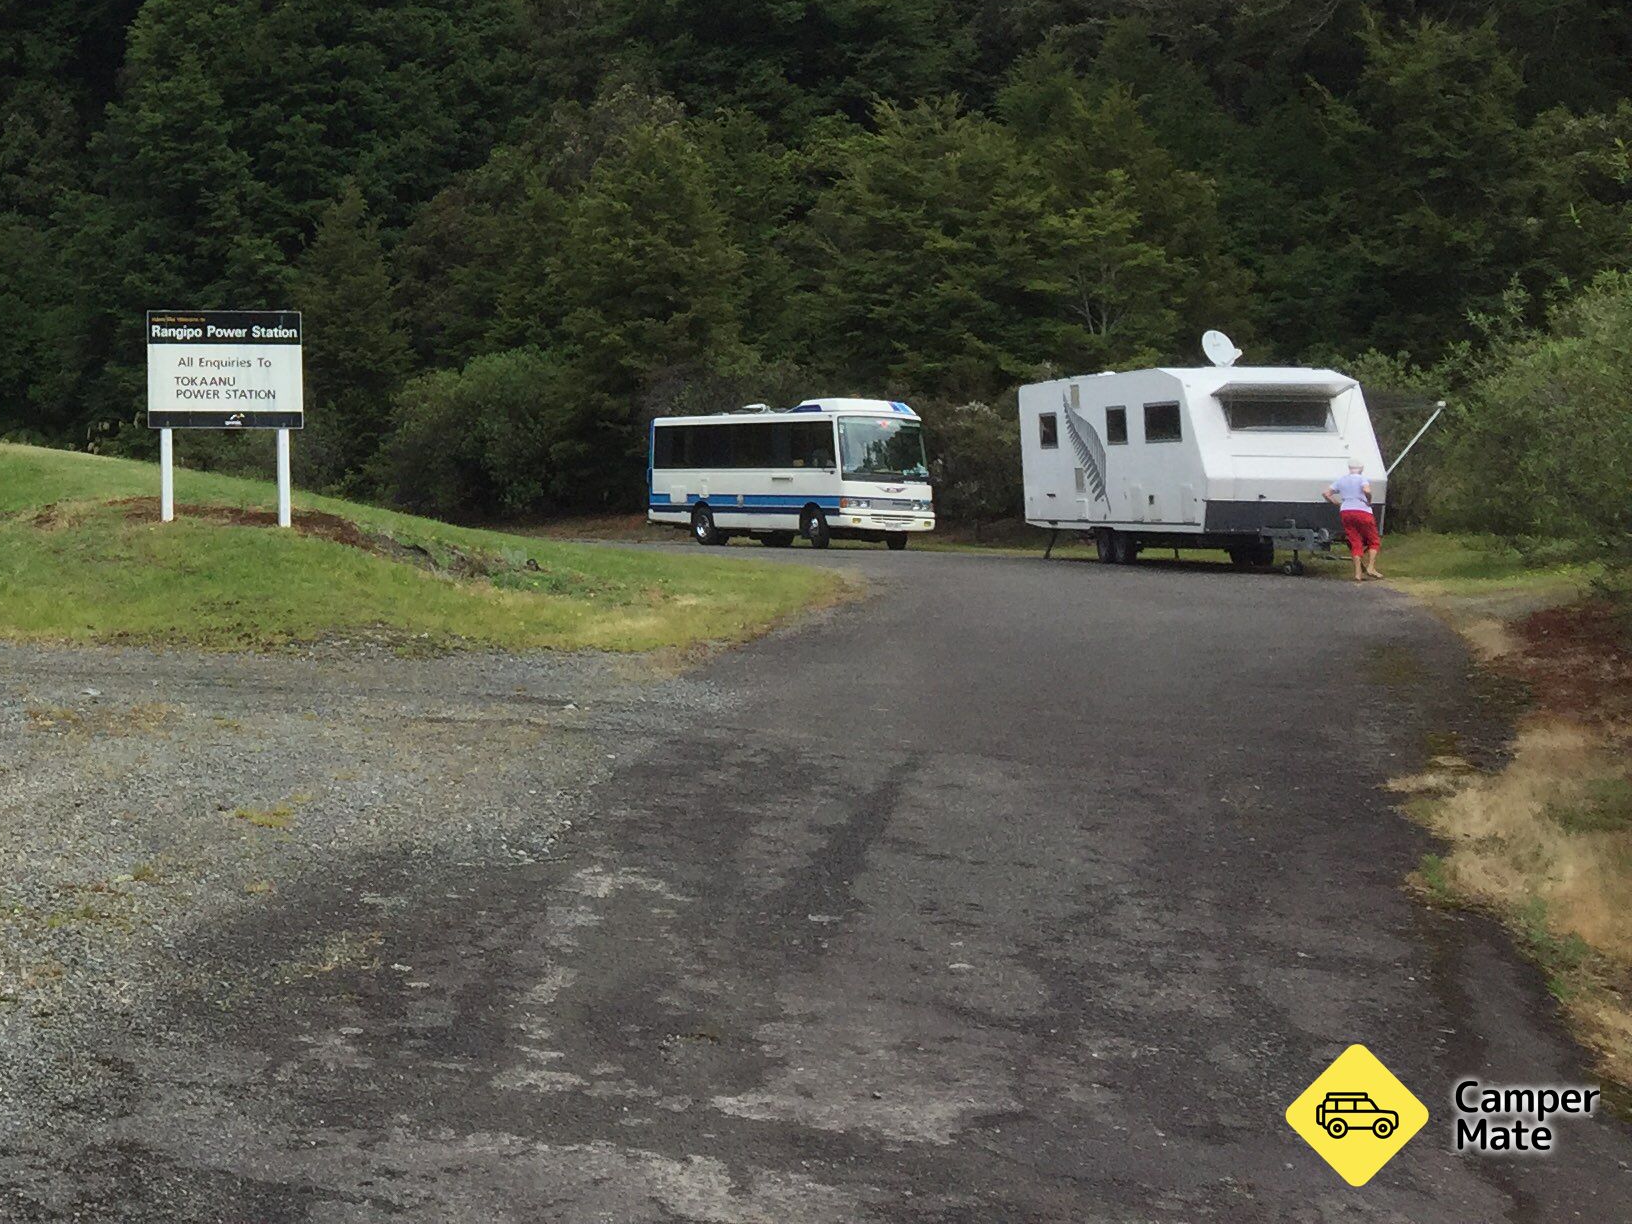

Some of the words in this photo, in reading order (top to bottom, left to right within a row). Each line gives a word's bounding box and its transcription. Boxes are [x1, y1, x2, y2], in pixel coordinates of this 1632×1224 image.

[151, 325, 202, 340] Rangipo
[207, 325, 247, 338] Power
[252, 325, 298, 338] Station
[178, 357, 193, 367] All
[199, 357, 252, 369] Enquiries
[258, 357, 272, 367] To
[174, 376, 236, 387] TOKAANU
[176, 389, 220, 399] POWER
[226, 389, 276, 399] STATION
